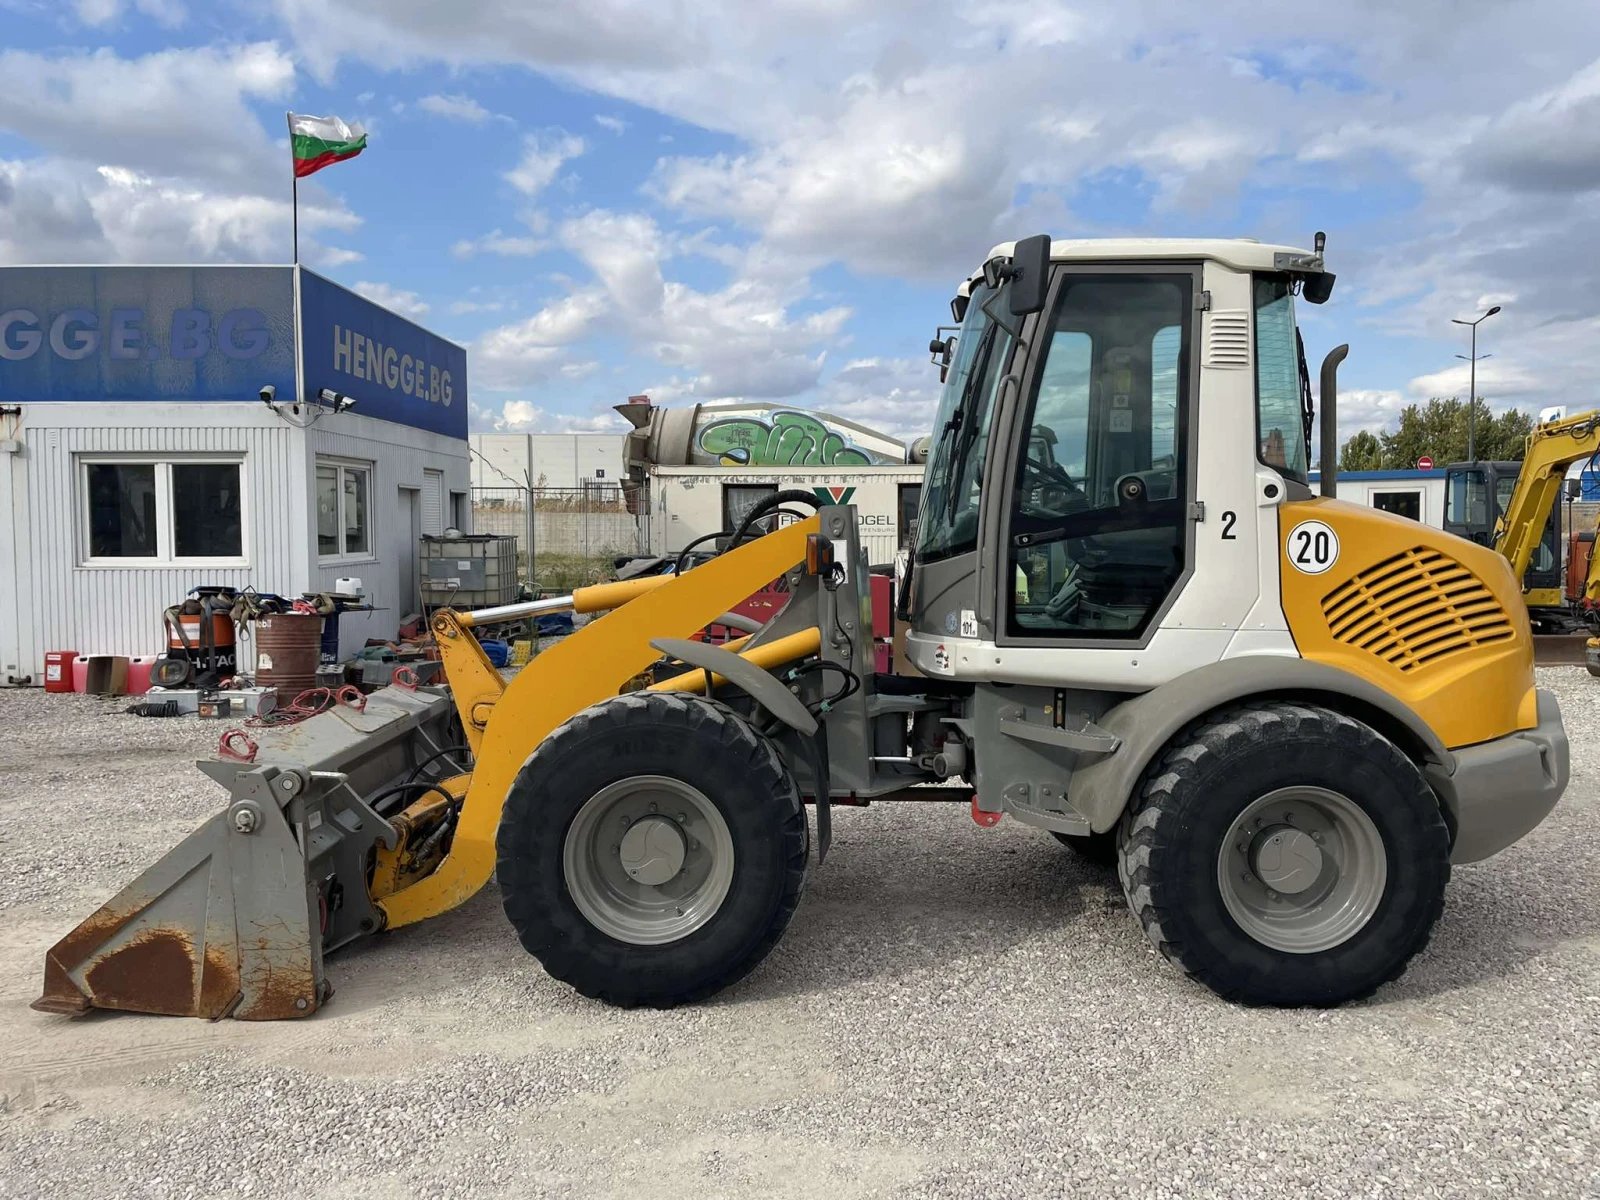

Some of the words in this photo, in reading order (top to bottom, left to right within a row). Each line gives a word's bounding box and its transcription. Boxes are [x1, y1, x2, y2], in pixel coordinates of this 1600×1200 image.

[334, 324, 453, 407] HENGGE.BG
[1220, 510, 1237, 540] 2
[1296, 530, 1329, 564] 20
[962, 621, 973, 636] 101
[190, 653, 236, 669] HAC
